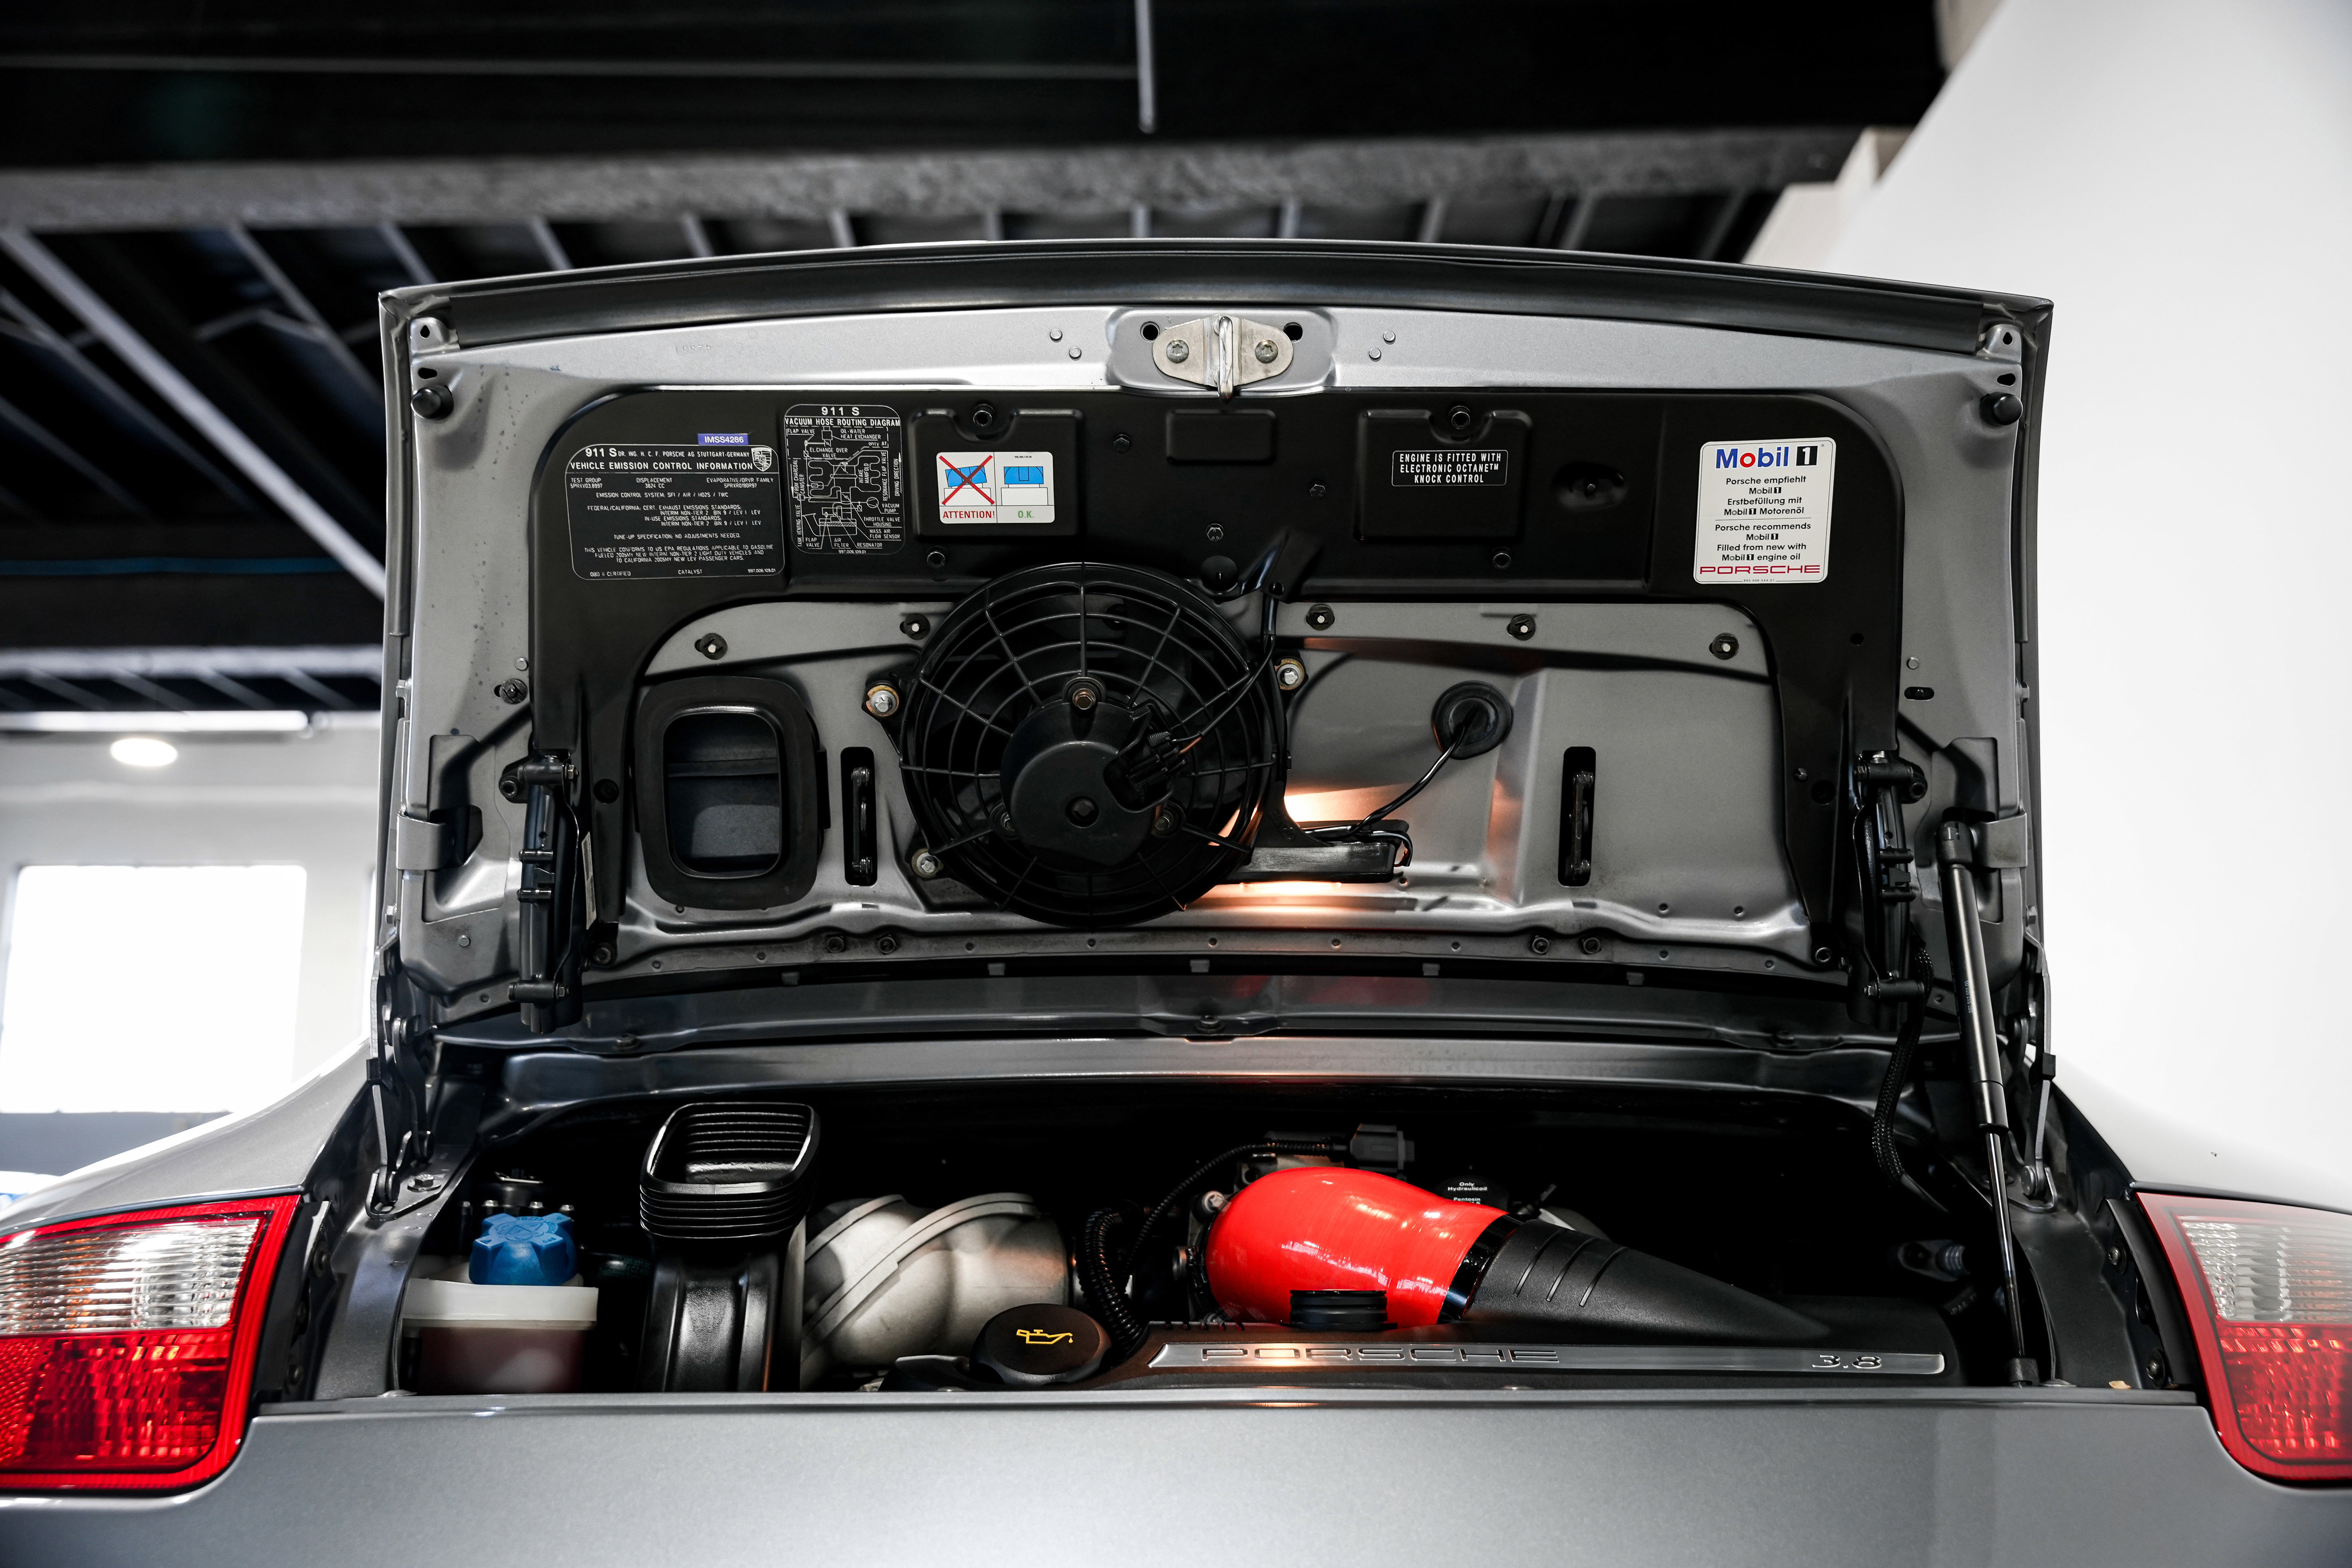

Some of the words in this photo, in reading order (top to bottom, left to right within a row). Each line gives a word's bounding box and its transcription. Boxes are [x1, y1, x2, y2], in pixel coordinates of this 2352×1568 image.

[821, 407, 844, 416] 911
[851, 407, 860, 416] S
[586, 448, 604, 457] 911
[609, 448, 617, 457] S
[1716, 446, 1789, 468] Mobil
[1400, 453, 1430, 462] ENGINE
[1434, 453, 1443, 462] IS
[1447, 453, 1476, 462] FITTED
[1481, 453, 1501, 462] WITH
[1400, 464, 1452, 473] ELECTRONIC
[1414, 474, 1441, 483] KNOCK
[1446, 474, 1483, 483] CONTROL
[1764, 476, 1806, 485] empfiehlt
[1728, 497, 1785, 506] Erstbefüllung
[1760, 507, 1804, 515] Motorenöl
[1753, 523, 1811, 531] recommends
[1757, 554, 1787, 562] engine
[1700, 565, 1820, 574] PORSCHE
[1202, 1347, 1560, 1363] PORSCHE
[1812, 1355, 1882, 1369] 3.8
